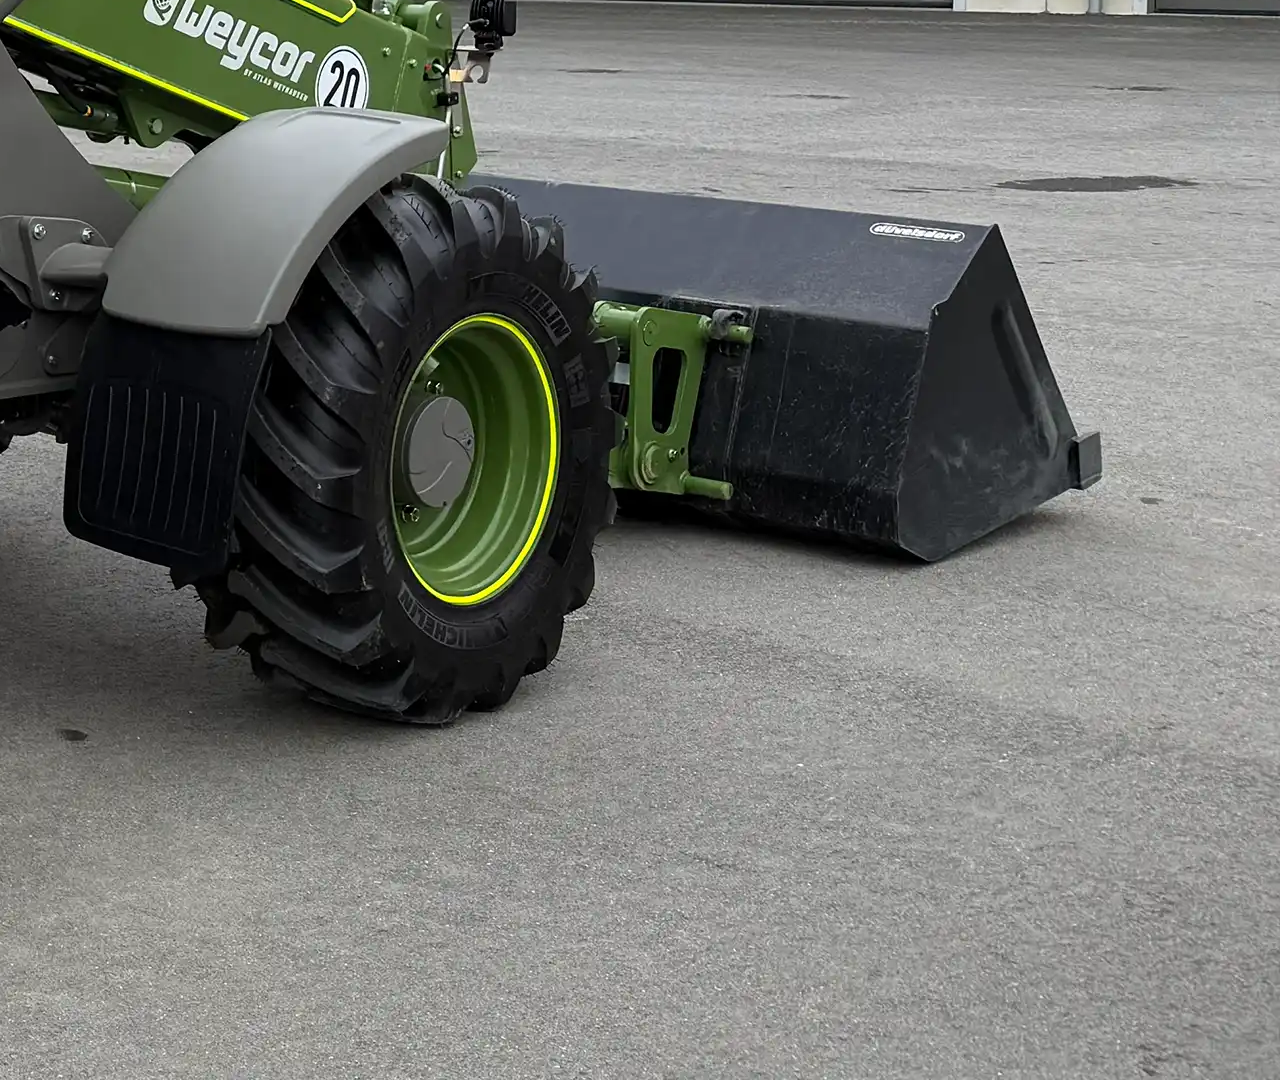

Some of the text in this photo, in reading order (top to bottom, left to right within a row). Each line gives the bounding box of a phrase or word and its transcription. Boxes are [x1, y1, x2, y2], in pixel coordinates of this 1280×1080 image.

[243, 67, 309, 103] BY ATLAS WEYHAUSEN
[322, 59, 361, 109] 20
